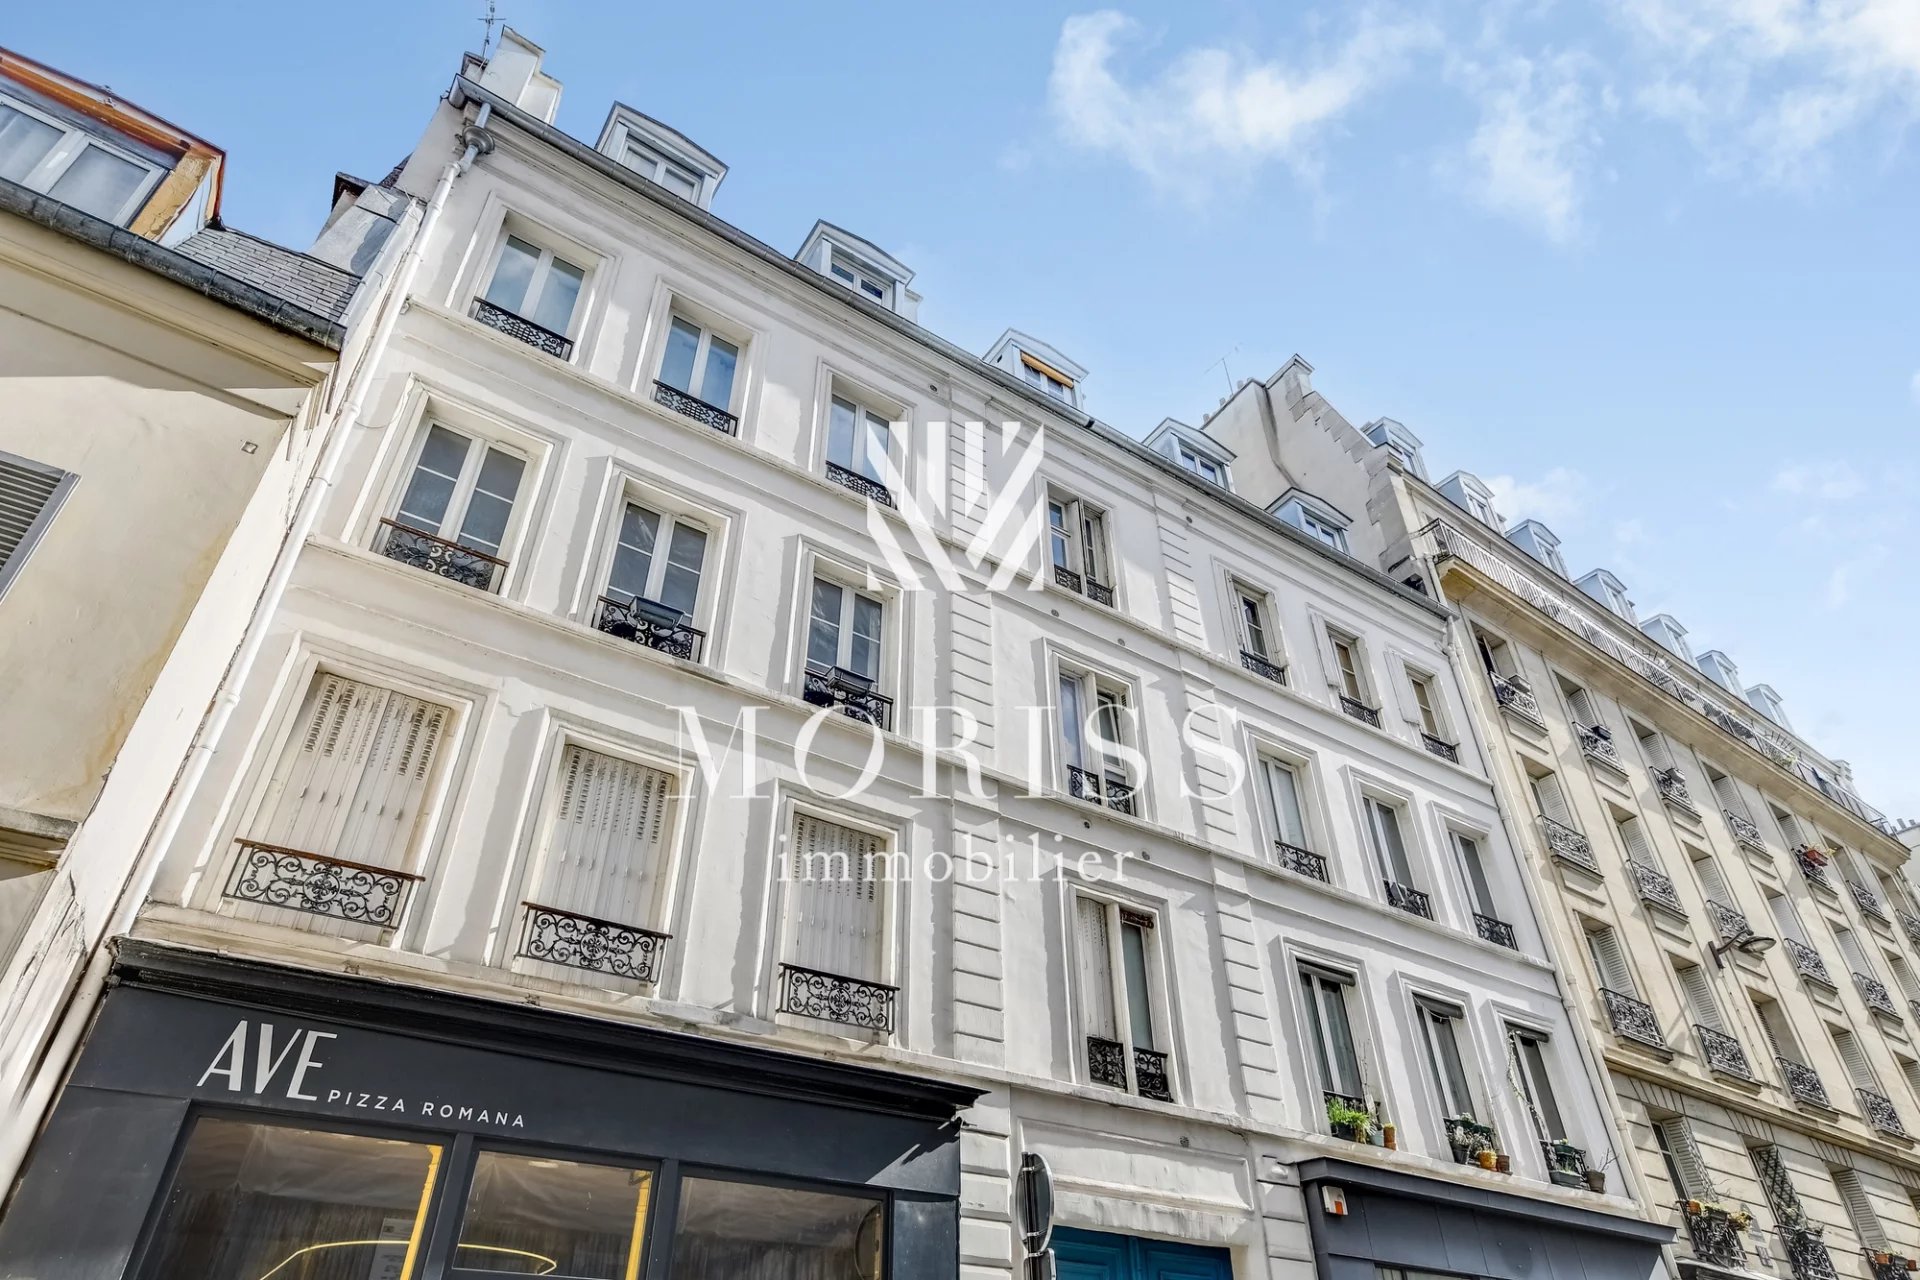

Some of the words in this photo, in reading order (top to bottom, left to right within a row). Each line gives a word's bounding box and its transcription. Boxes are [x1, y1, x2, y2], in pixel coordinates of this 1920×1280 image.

[196, 1019, 338, 1102] AVE
[327, 1089, 405, 1113] PIZZA
[421, 1102, 525, 1128] ROMANA
